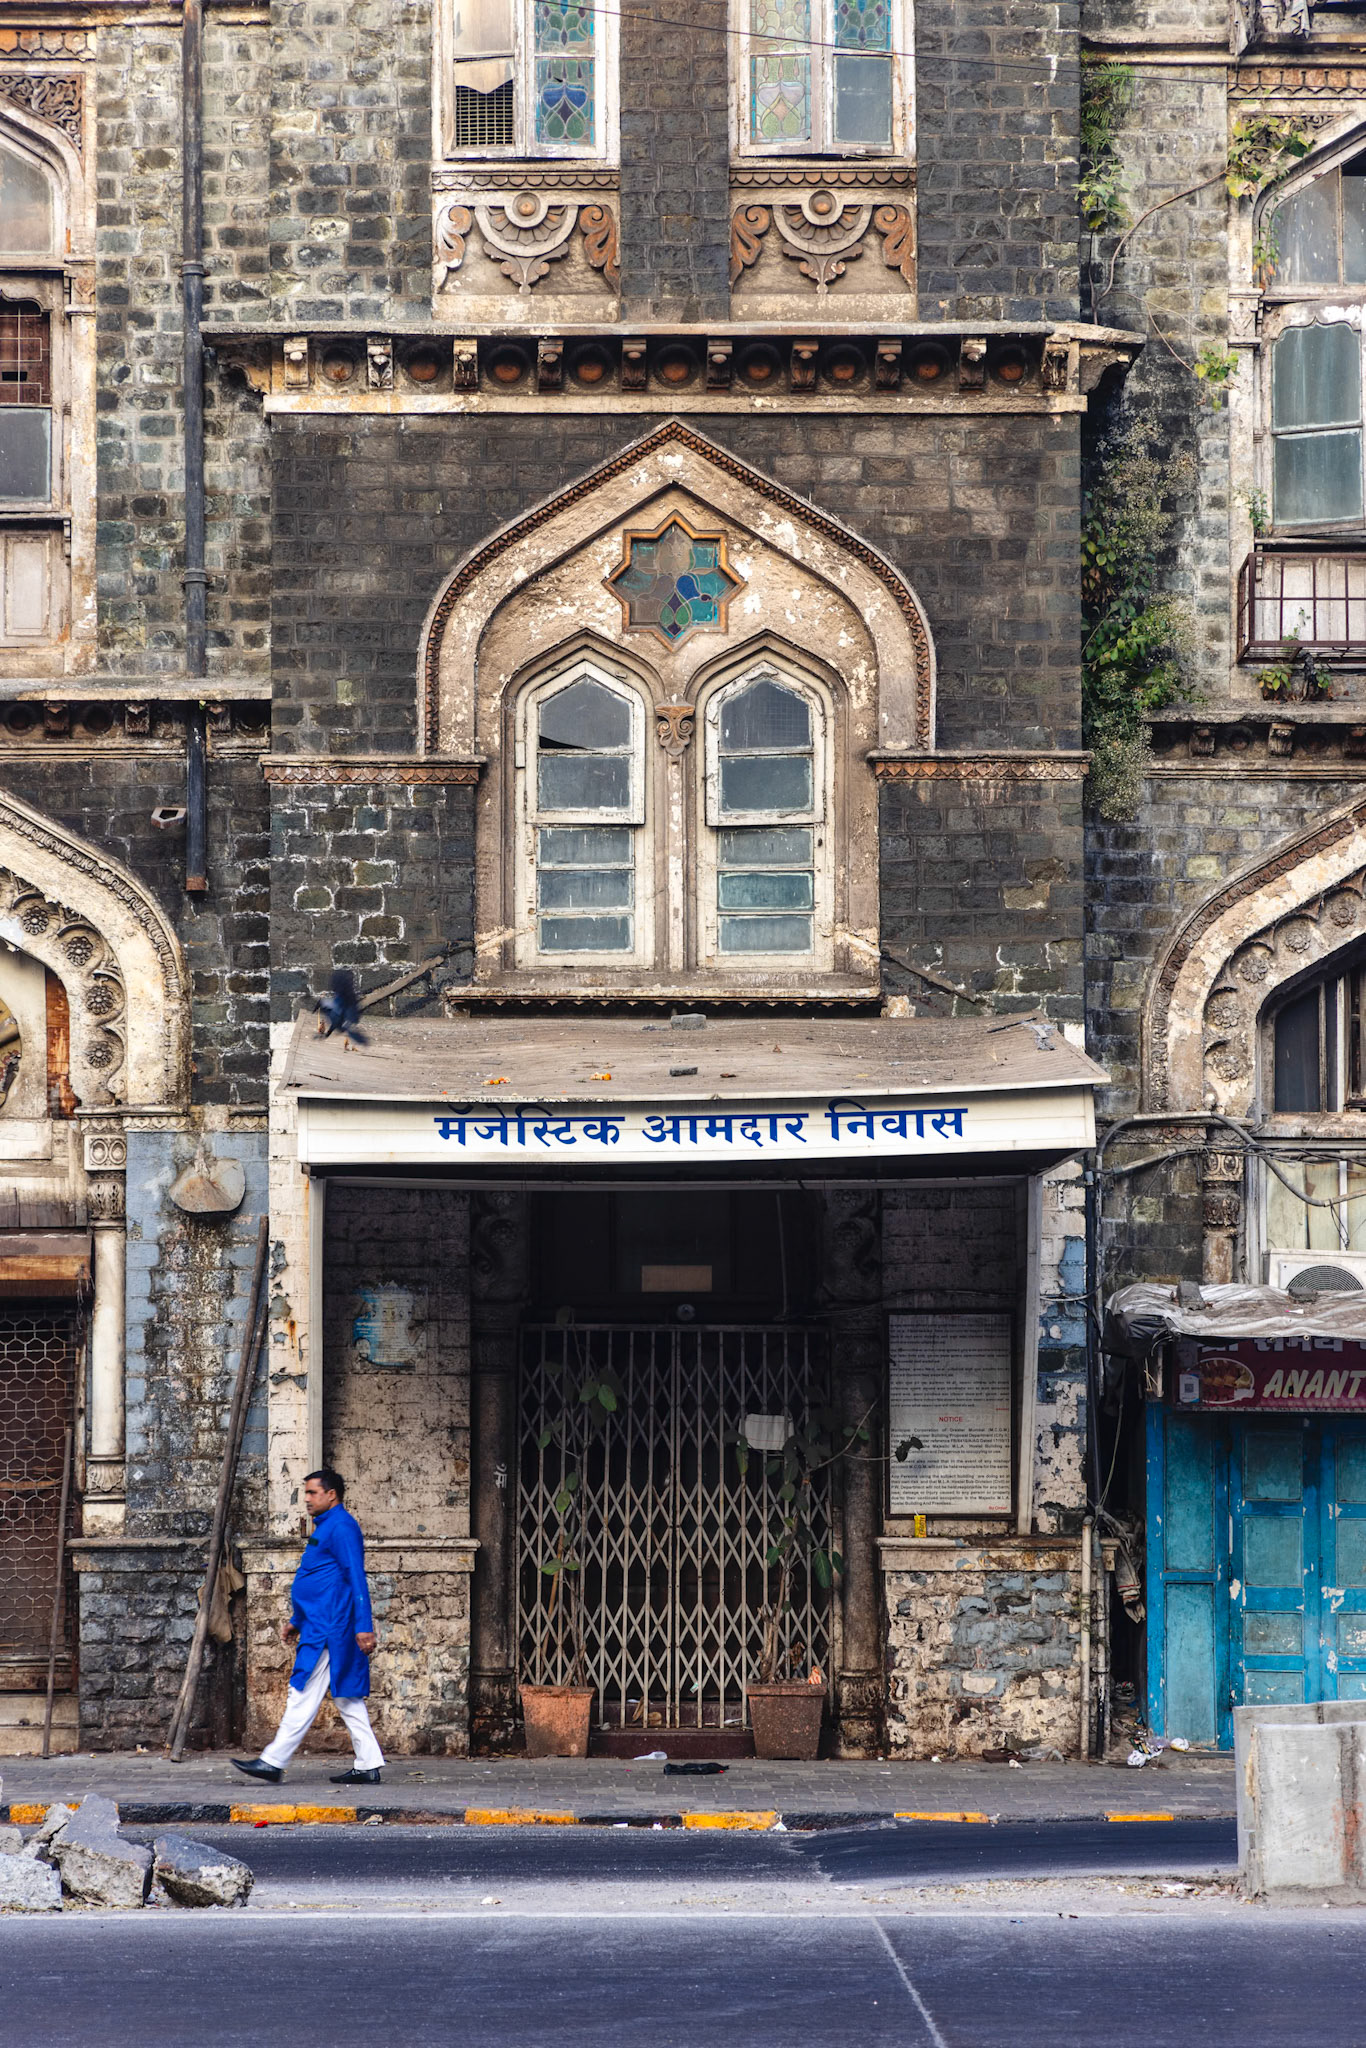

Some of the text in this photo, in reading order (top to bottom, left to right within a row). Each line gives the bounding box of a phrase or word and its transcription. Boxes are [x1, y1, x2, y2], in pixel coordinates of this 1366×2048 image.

[434, 1098, 968, 1147] मॅजेस्टिक आमदार निवास
